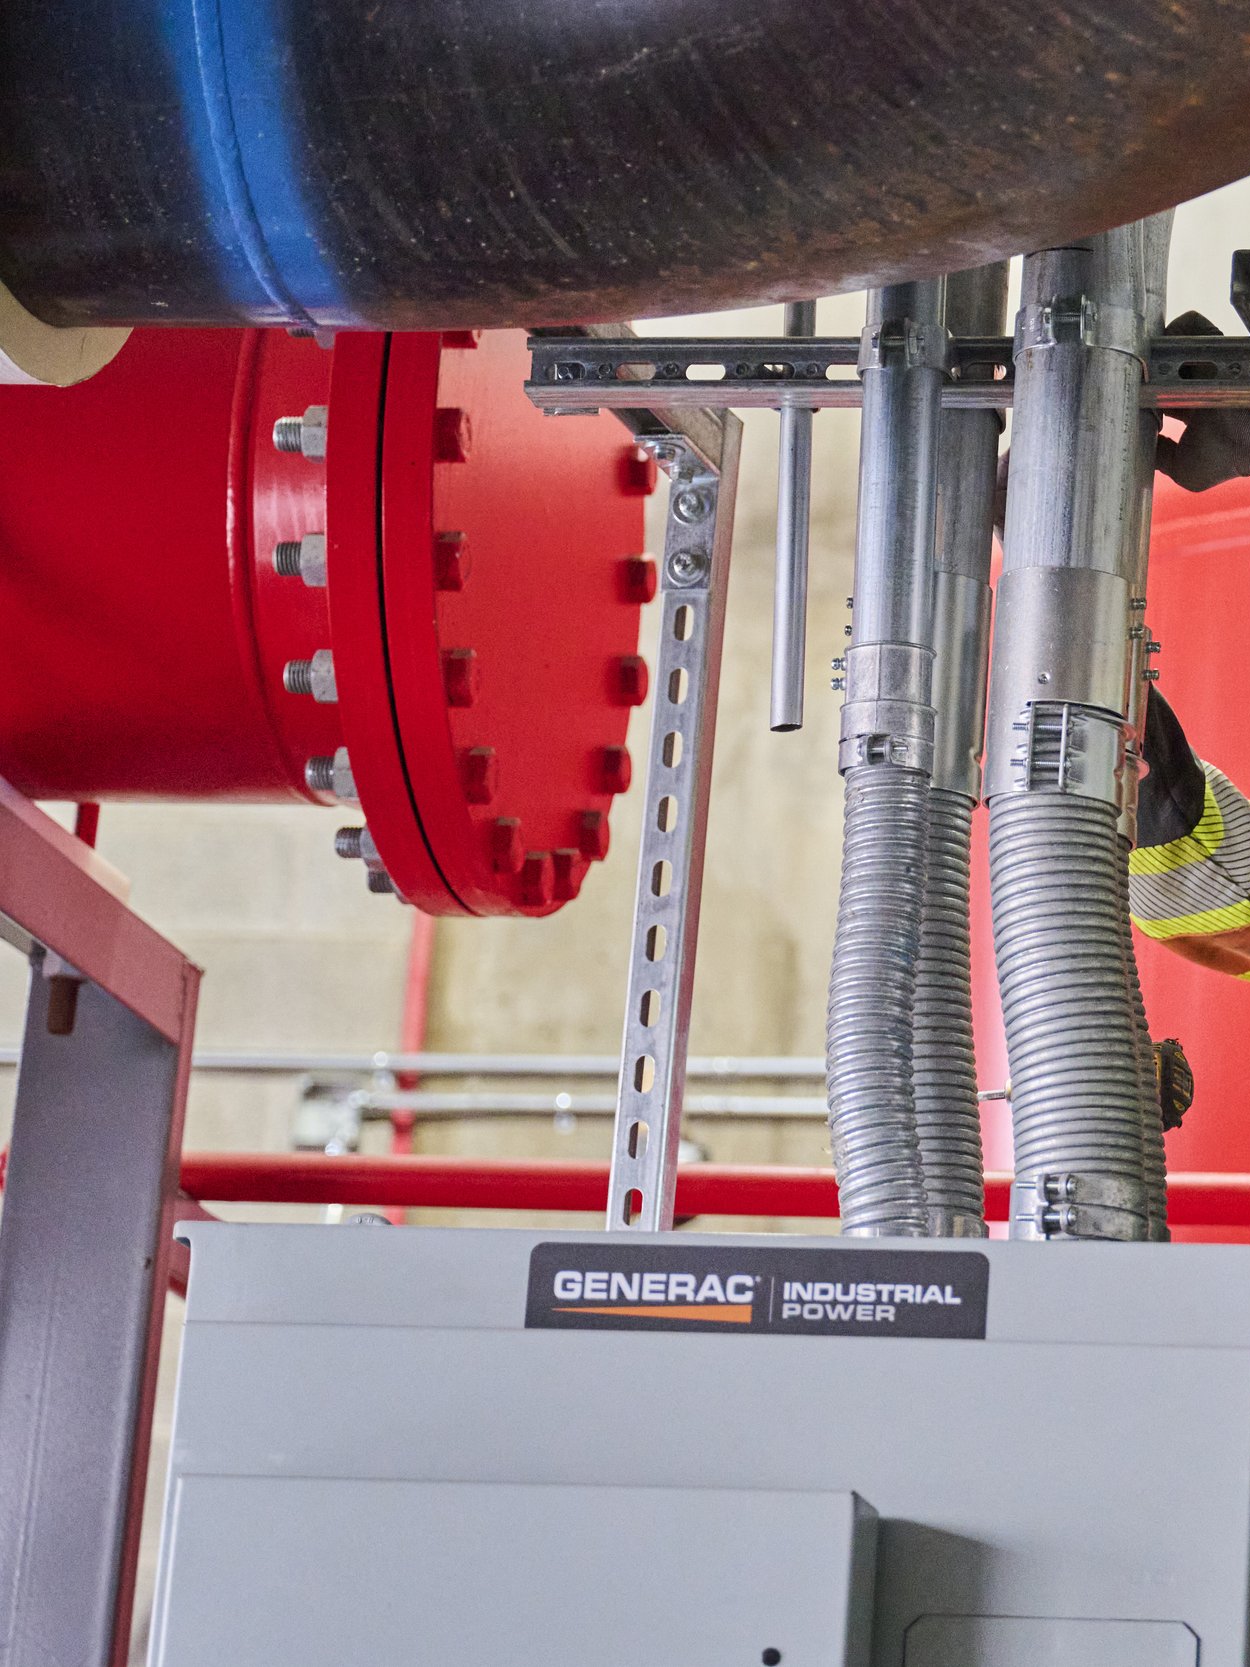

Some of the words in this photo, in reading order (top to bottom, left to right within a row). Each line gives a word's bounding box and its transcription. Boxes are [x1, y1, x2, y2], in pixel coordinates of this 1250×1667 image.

[553, 1270, 755, 1303] GENERAC
[783, 1281, 962, 1305] INDUSTRIAL
[782, 1303, 896, 1322] POWER
